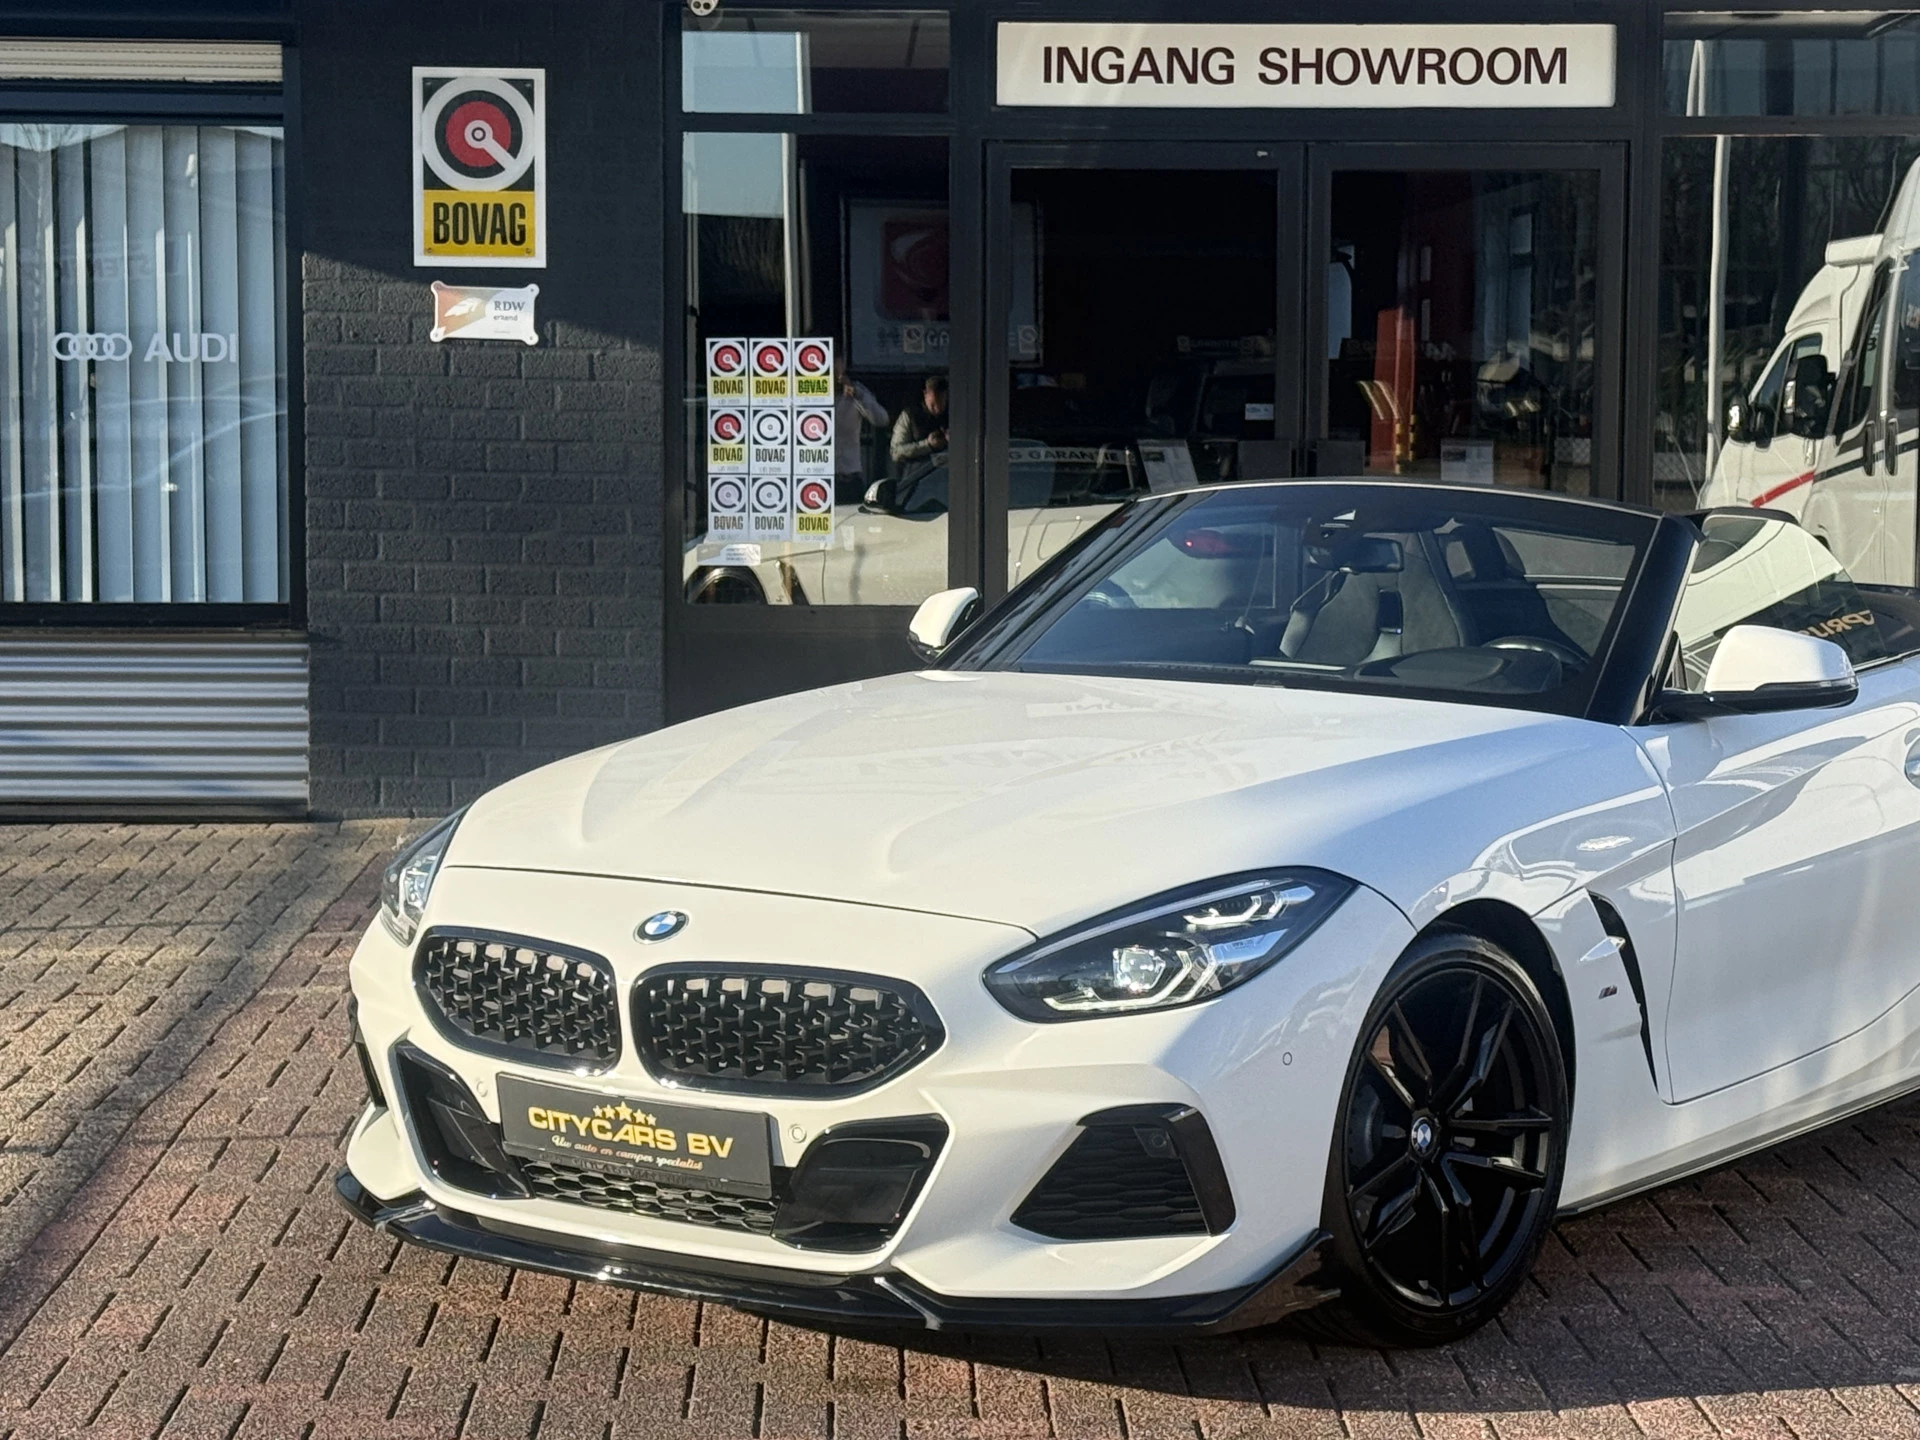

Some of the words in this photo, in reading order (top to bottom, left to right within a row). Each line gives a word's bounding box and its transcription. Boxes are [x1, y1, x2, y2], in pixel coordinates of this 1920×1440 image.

[1043, 46, 1235, 85] INGANG
[1257, 47, 1568, 85] SHOWROOM
[433, 202, 526, 246] BOVAG
[494, 300, 525, 311] RDW
[144, 332, 237, 363] AUDI
[713, 379, 744, 395] BOVAG
[755, 379, 786, 395] BOVAG
[798, 379, 828, 394] BOVAG
[713, 447, 743, 462] BOVAG
[755, 448, 785, 462] BOVAG
[799, 449, 829, 463] BOVAG
[713, 515, 744, 530] BOVAG
[755, 516, 785, 530] BOVAG
[799, 516, 829, 531] BOVAG
[528, 1106, 677, 1151] CITYCARS
[687, 1132, 733, 1158] BV
[574, 1143, 598, 1153] auto
[600, 1148, 613, 1156] en
[616, 1150, 653, 1163] camper
[656, 1156, 703, 1170] specialist
